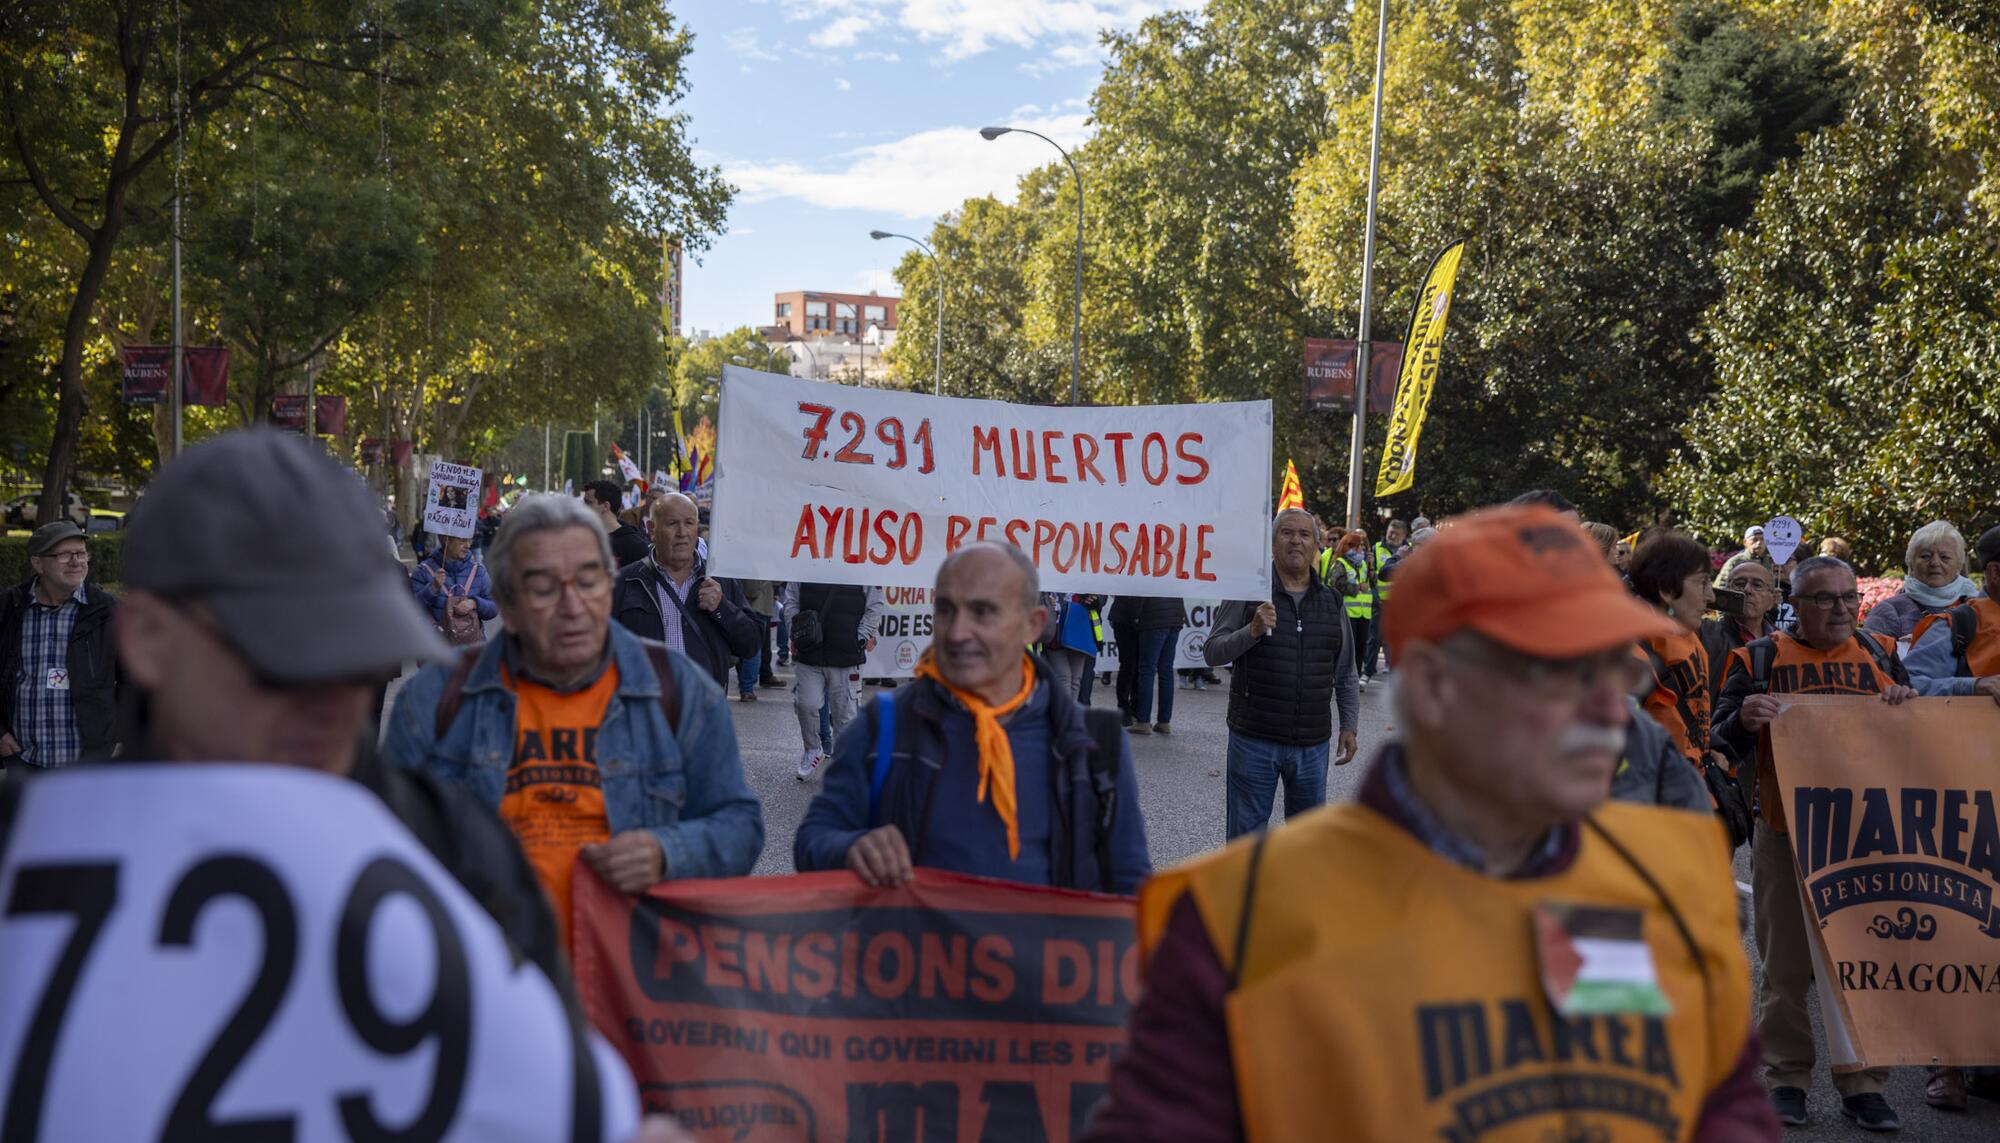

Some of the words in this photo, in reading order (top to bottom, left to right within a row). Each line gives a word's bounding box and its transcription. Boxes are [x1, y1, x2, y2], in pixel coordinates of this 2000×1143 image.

[124, 368, 168, 378] RUBENS
[1307, 366, 1353, 379] RUBENS
[799, 401, 935, 475] 7.291
[972, 425, 1210, 486] MUERTOS
[791, 503, 923, 565] AYUSO
[1772, 662, 1880, 693] MAREA
[1795, 786, 2000, 884] MAREA
[1821, 870, 1984, 910] PENSIONISTA
[655, 915, 1017, 1003] PENSIONS
[627, 1015, 769, 1056] GOVERNI
[780, 1031, 831, 1059] QUI
[845, 1036, 997, 1063] GOVERNI
[1008, 1039, 1073, 1065] LES
[1417, 998, 1681, 1101] MAREA
